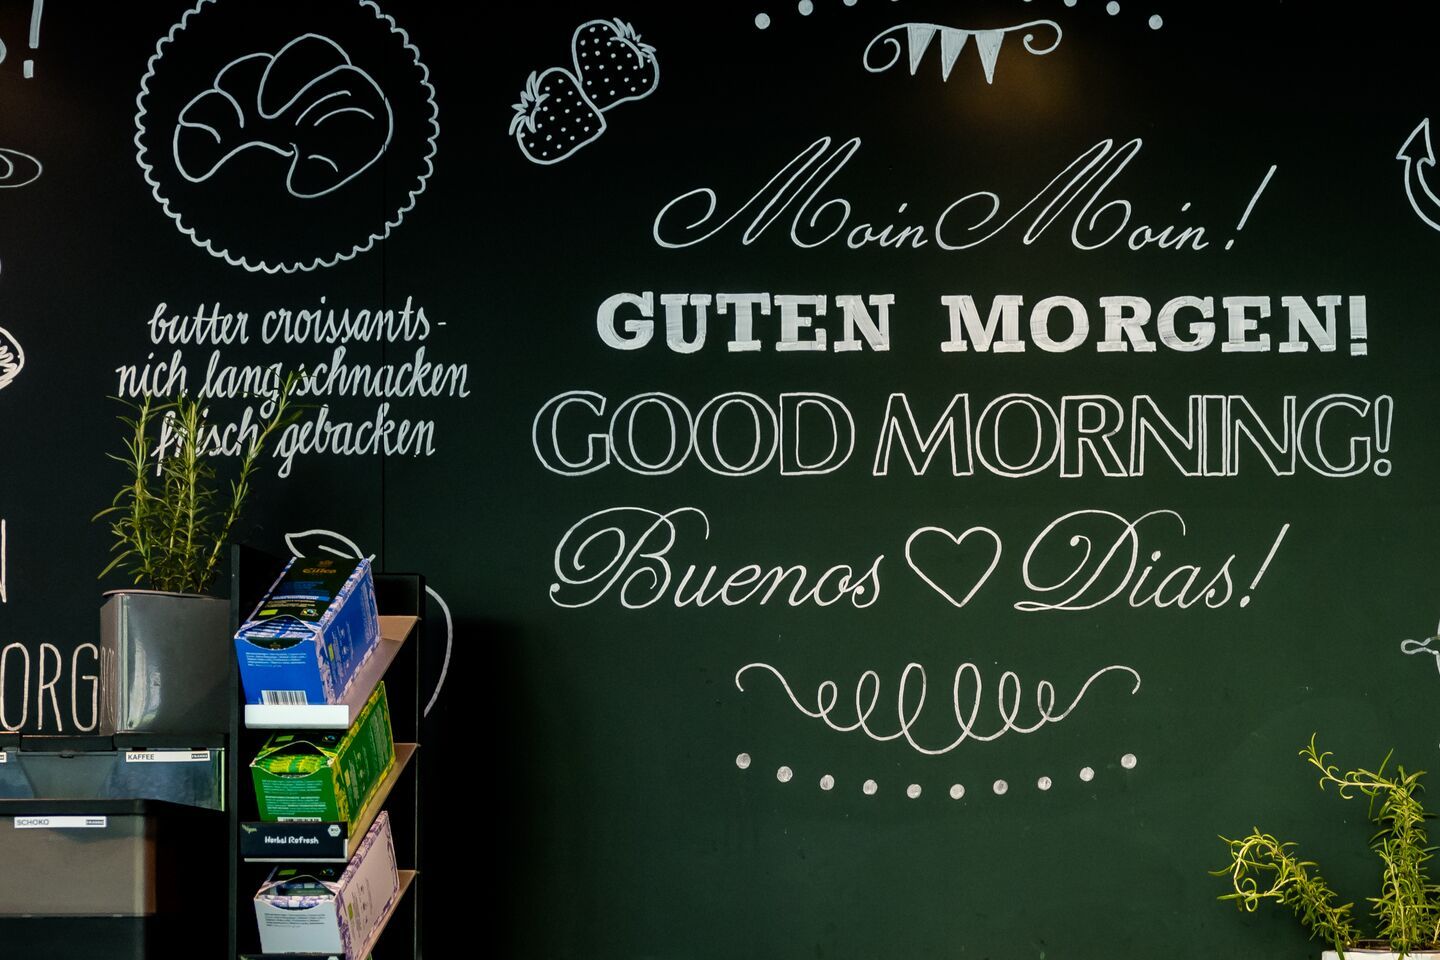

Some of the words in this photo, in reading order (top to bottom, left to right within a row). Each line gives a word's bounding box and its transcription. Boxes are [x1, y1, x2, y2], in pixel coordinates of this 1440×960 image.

[654, 136, 928, 250] Moin
[148, 303, 248, 346] butter
[597, 291, 896, 354] GUTEN
[941, 294, 1368, 357] MORGEN!
[116, 350, 188, 398] nich
[199, 350, 282, 419] lang
[289, 346, 470, 399] schnacken
[273, 402, 436, 478] gebacken
[532, 390, 855, 477] GOOD
[872, 392, 1394, 478] MORNING!
[549, 507, 885, 609] Buenos
[1014, 509, 1290, 611] Dias!
[127, 753, 155, 761] KAFFEE
[16, 819, 50, 827] SCHOKO
